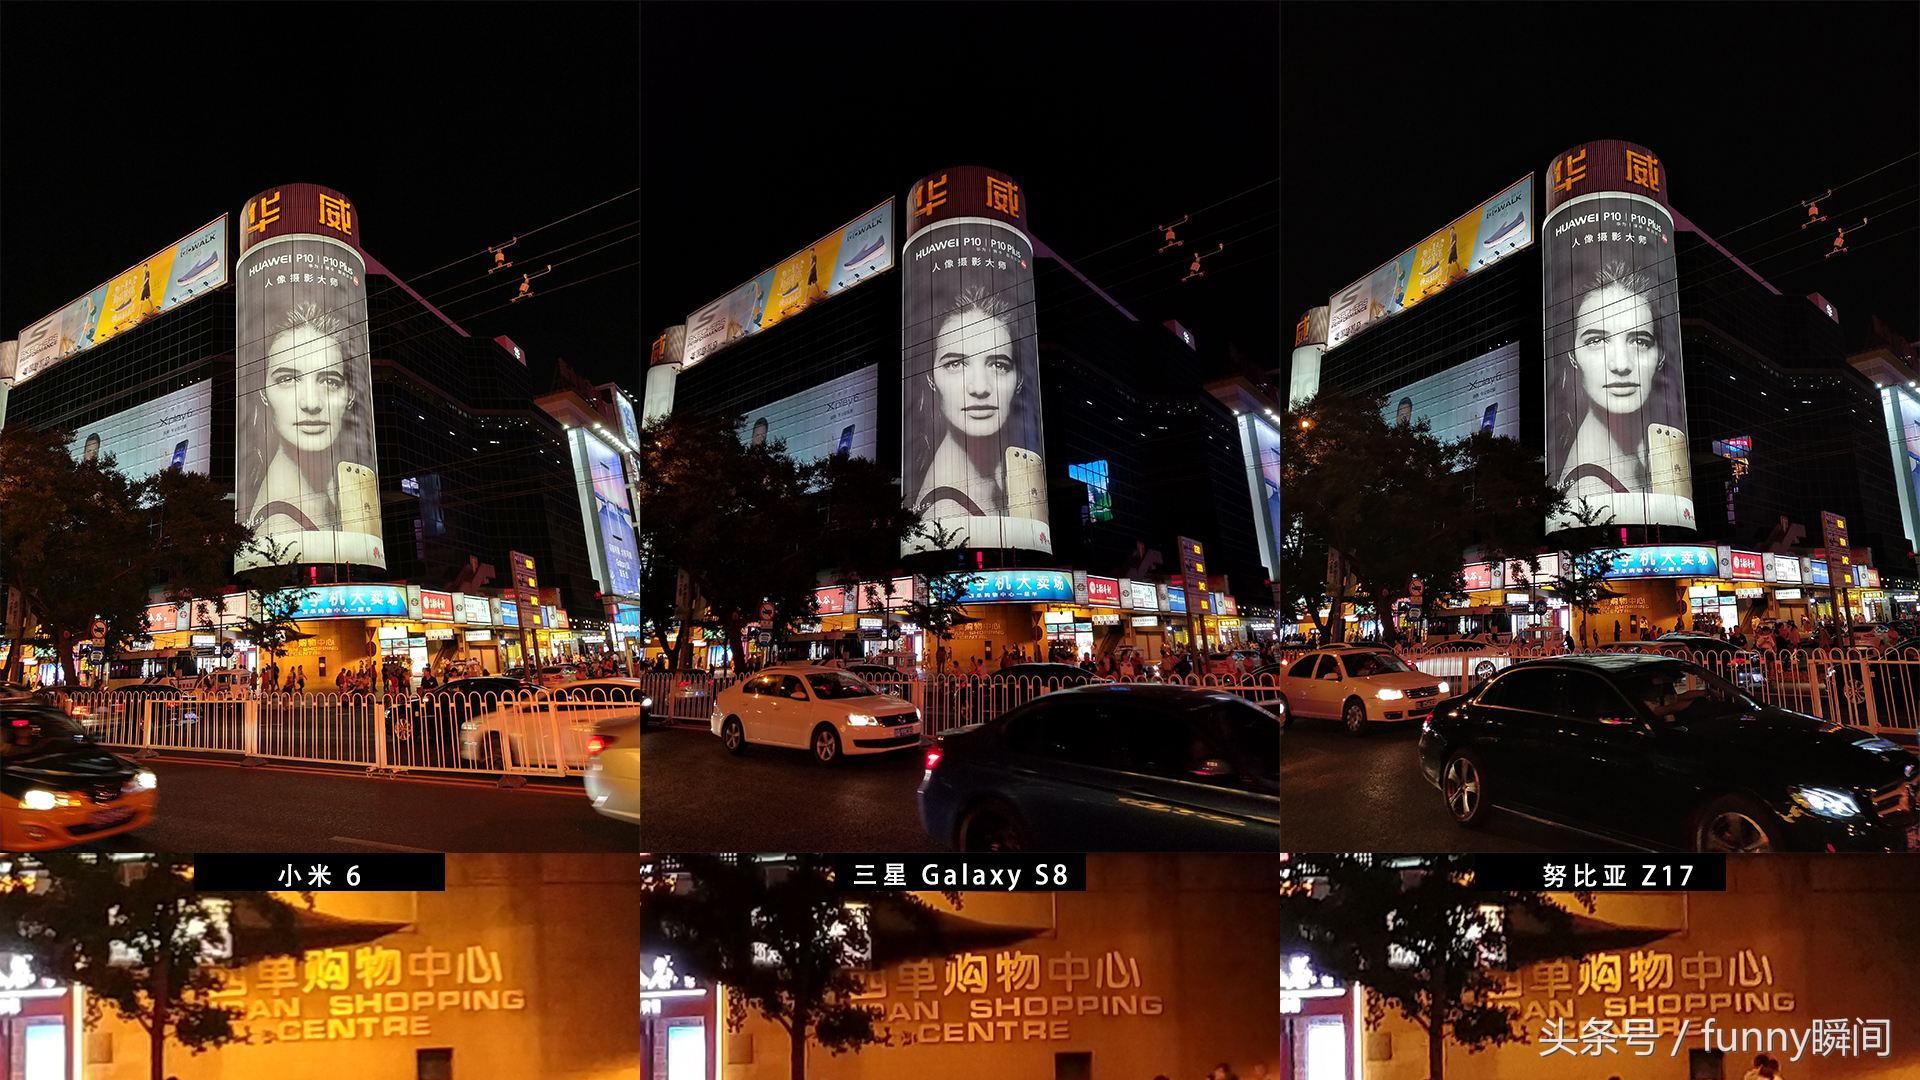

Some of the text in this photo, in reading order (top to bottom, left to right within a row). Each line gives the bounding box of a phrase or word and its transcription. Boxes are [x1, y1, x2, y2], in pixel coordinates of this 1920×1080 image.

[1553, 148, 1659, 192] 华威
[913, 174, 1019, 218] 华威
[247, 191, 352, 235] 华威
[1555, 213, 1599, 237] HUAWEI
[1603, 211, 1622, 221] P10
[1630, 213, 1646, 225] P10
[1647, 218, 1662, 233] Plus
[915, 238, 960, 261] HUAWEI
[963, 237, 982, 246] P10
[990, 239, 1006, 251] P10
[1571, 232, 1647, 248] 人像摄影大师
[249, 254, 292, 277] HUAWEI
[296, 253, 314, 263] P10
[323, 255, 339, 268] P10
[932, 257, 1007, 273] 人像摄影大师
[264, 273, 339, 288] 人像摄影大师
[329, 989, 526, 1016] SHOPPING
[969, 995, 1164, 1020] SHOPPING
[1603, 991, 1796, 1018] SHOPPING
[277, 1015, 432, 1042] CENTRE
[917, 1019, 1071, 1044] CENTRE
